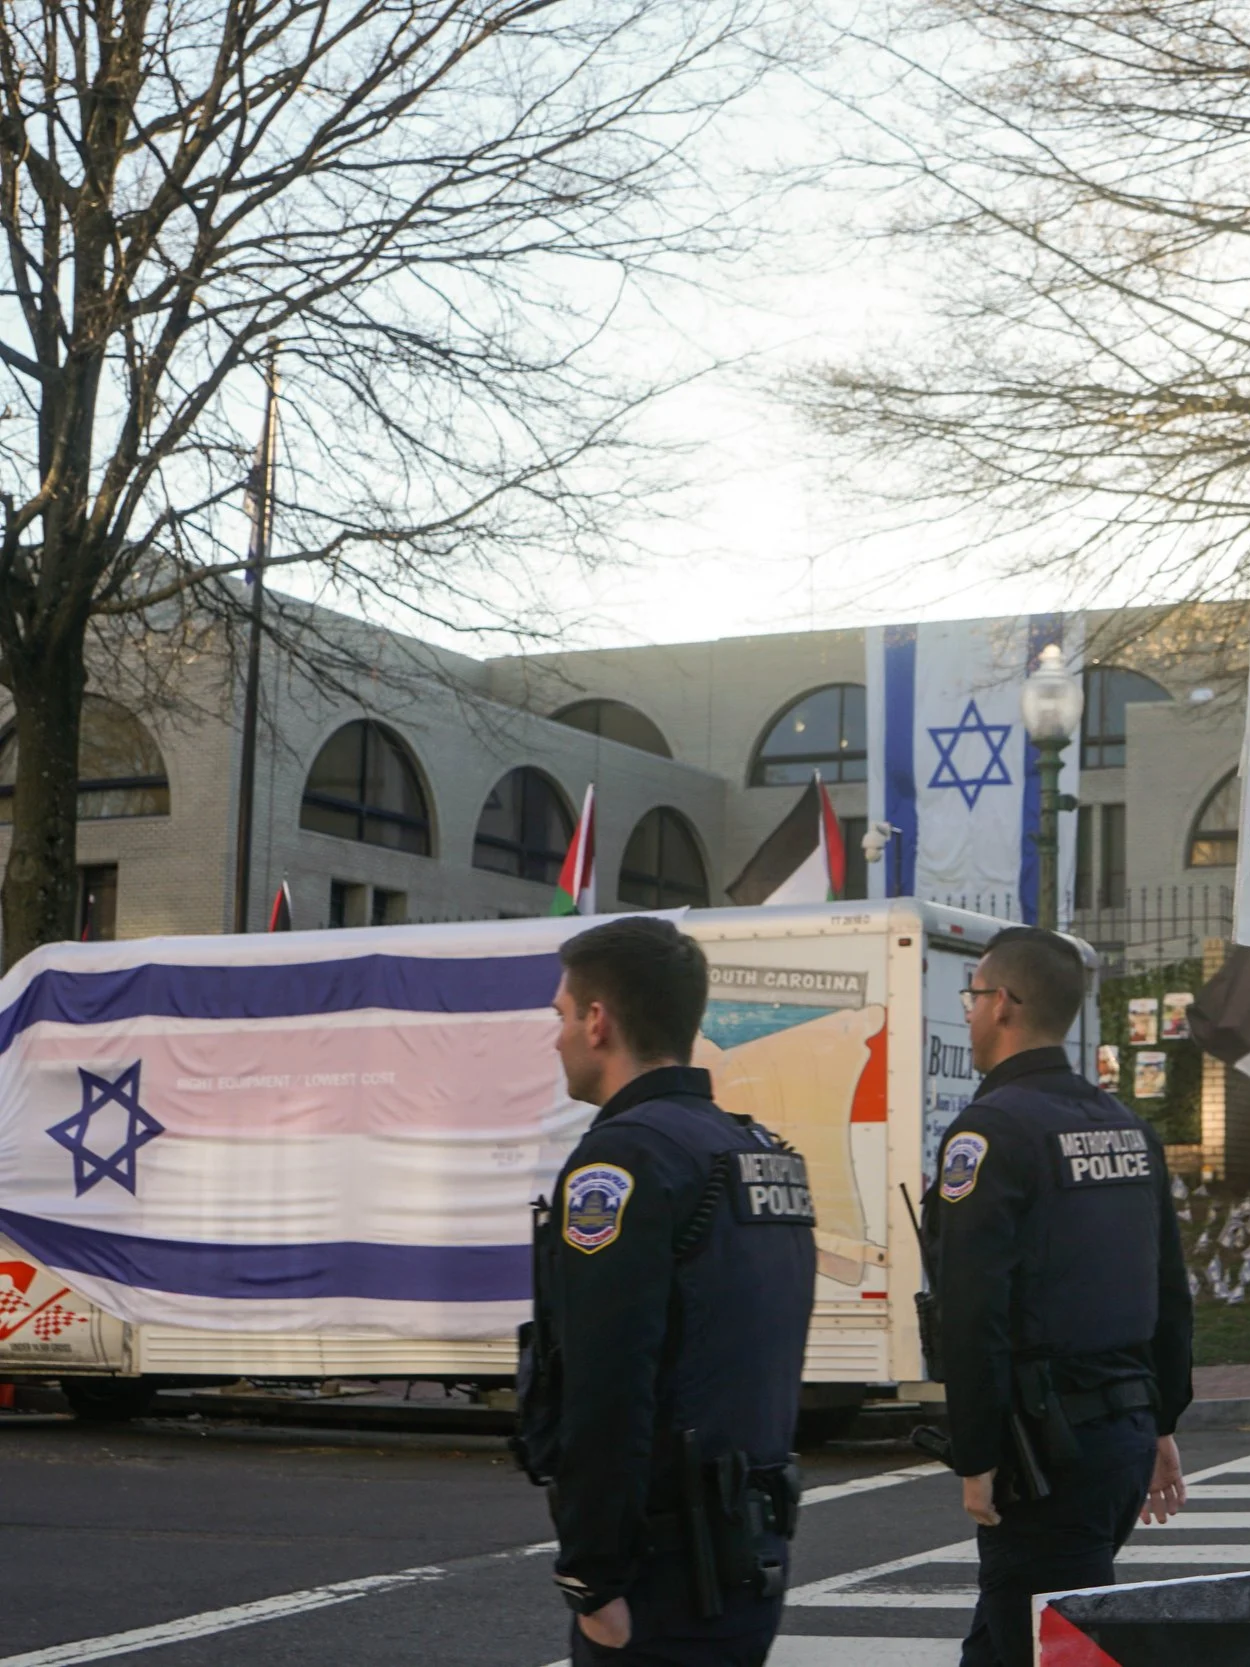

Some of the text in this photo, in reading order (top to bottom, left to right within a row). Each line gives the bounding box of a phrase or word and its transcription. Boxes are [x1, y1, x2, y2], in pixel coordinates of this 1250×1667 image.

[707, 968, 860, 991] OUTH CAROLINA
[1069, 1153, 1151, 1182] POLICE
